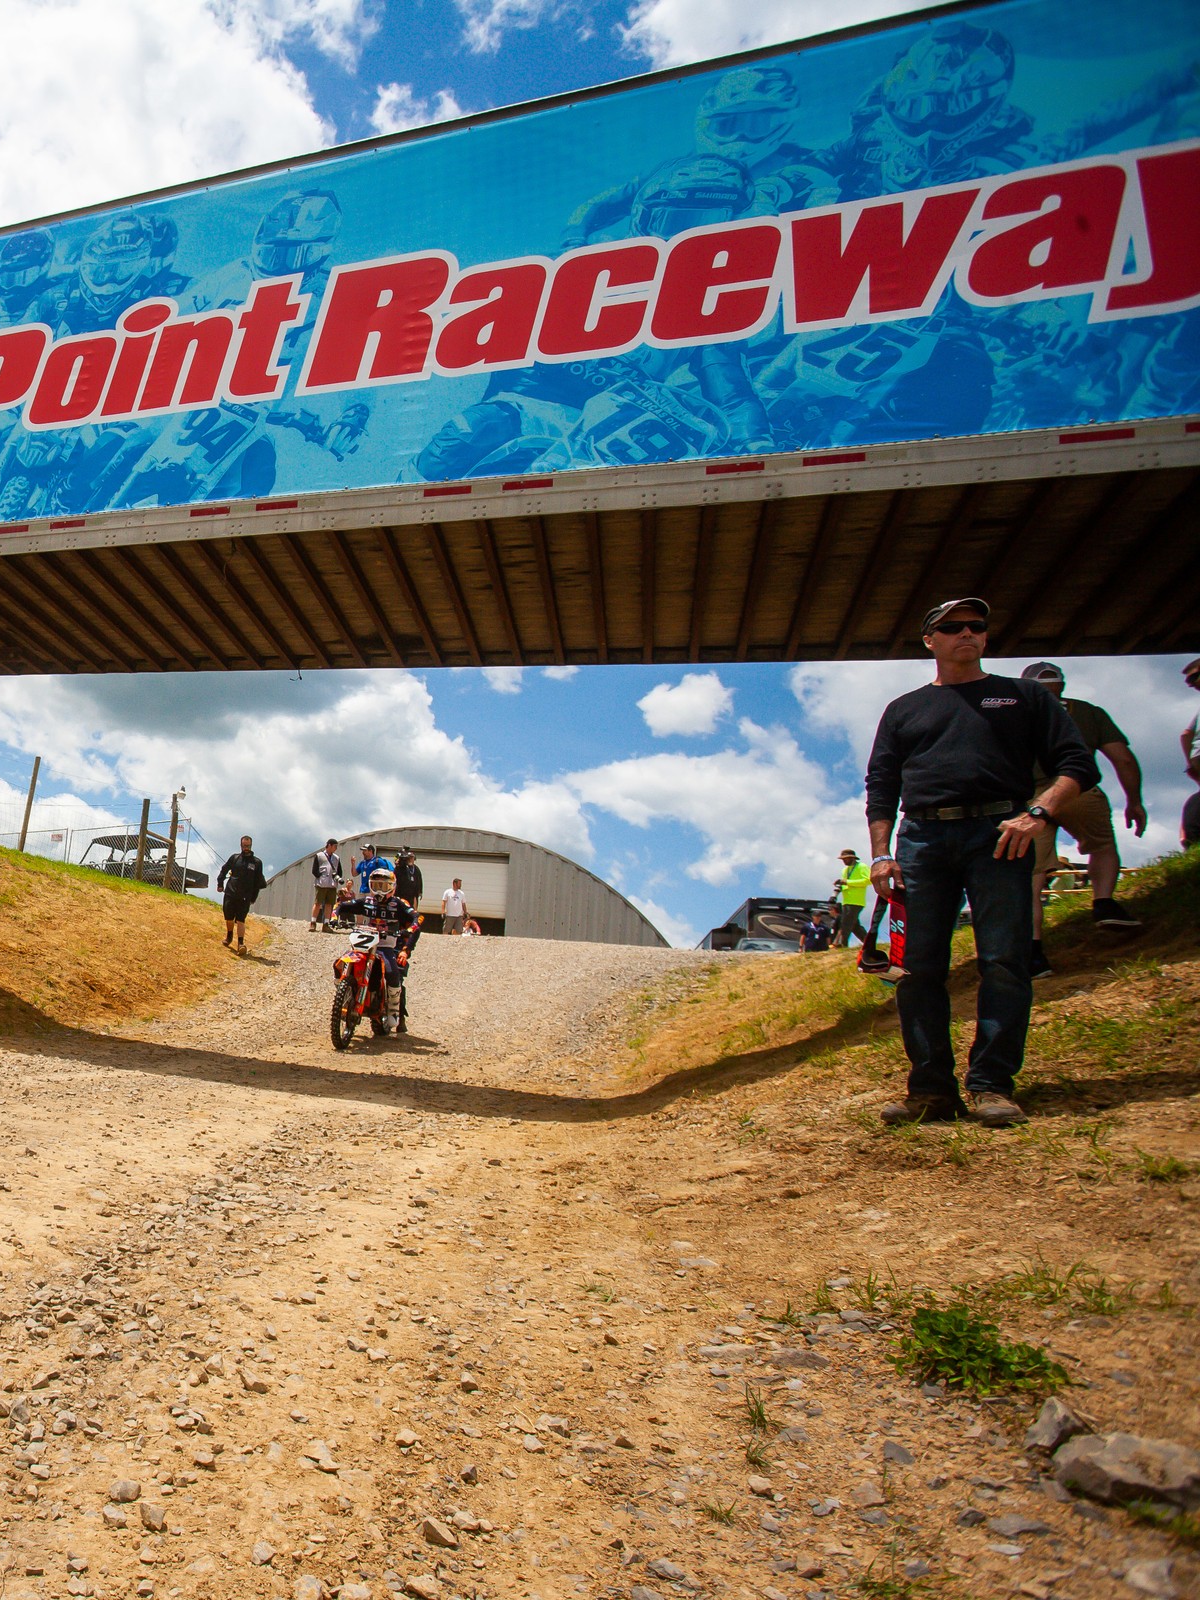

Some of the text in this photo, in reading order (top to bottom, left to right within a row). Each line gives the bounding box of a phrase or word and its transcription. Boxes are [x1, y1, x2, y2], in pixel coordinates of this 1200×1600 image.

[637, 398, 681, 430] LUCAS OIL
[353, 934, 375, 949] 2
[889, 919, 905, 968] 100%
